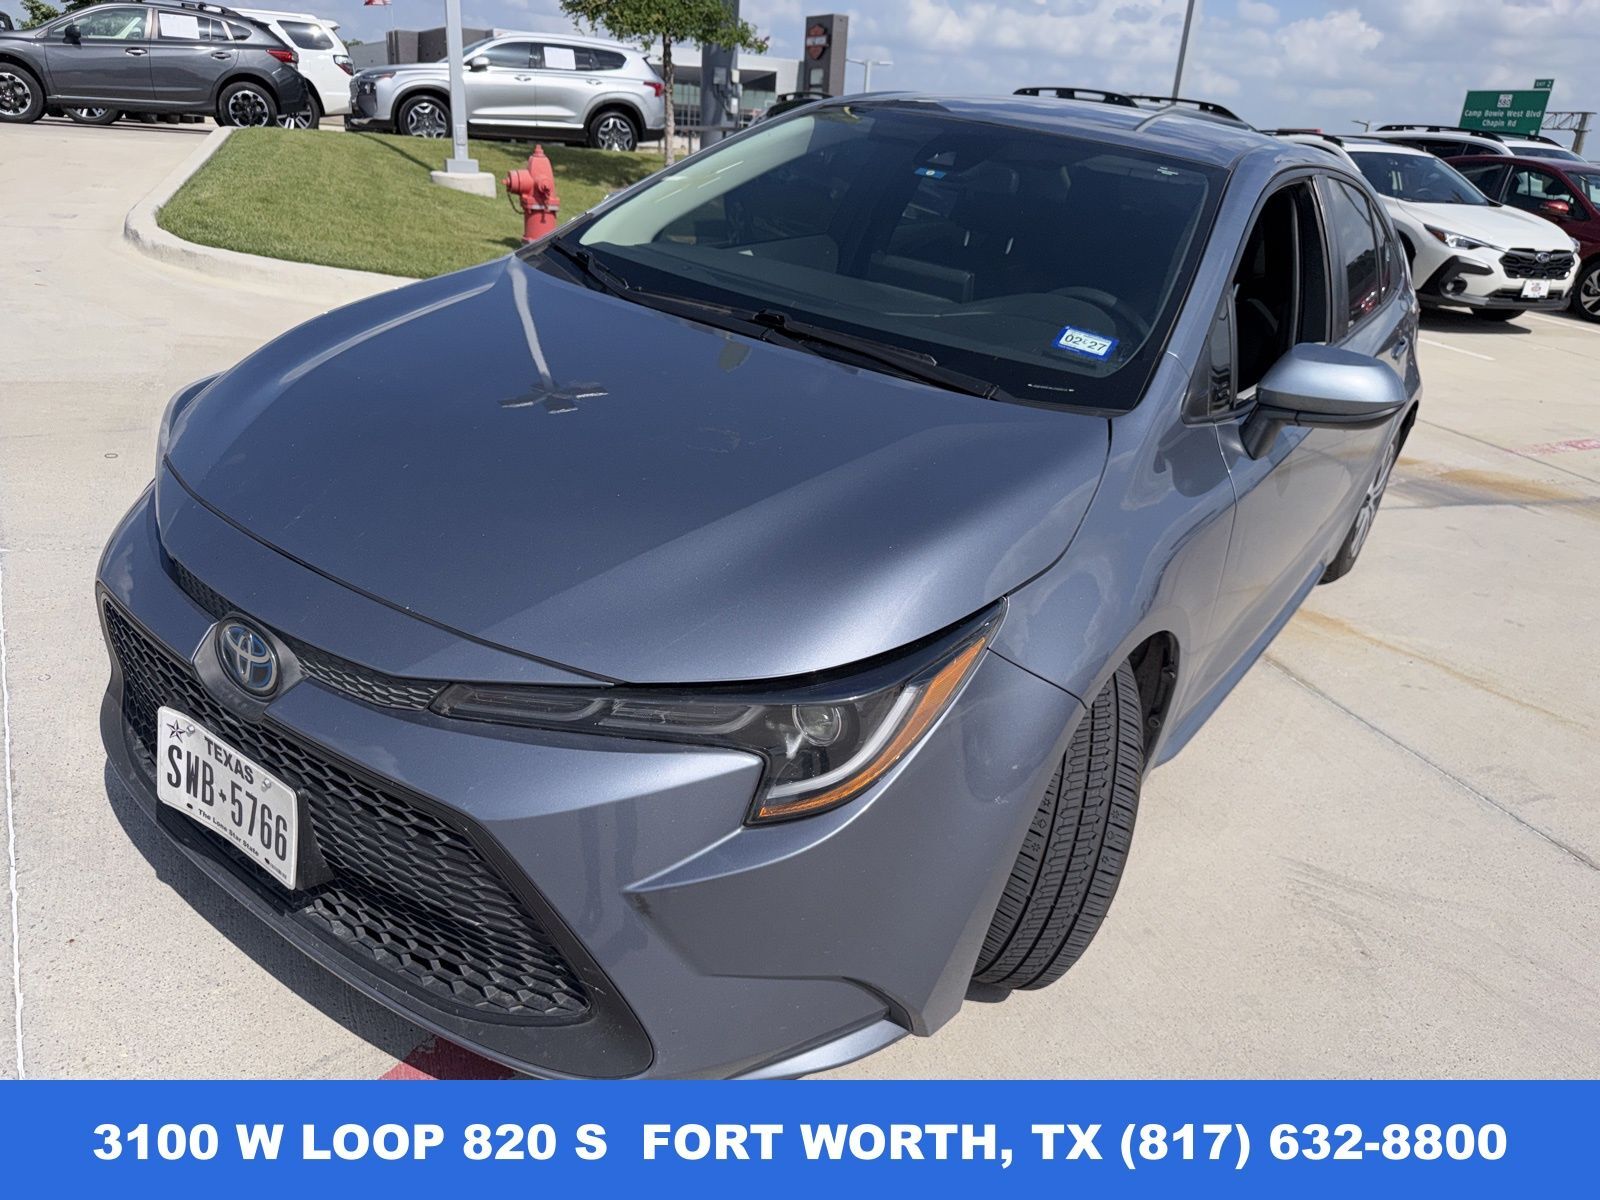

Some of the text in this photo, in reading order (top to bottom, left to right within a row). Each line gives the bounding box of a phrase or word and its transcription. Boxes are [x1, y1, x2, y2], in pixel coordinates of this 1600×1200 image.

[1464, 109, 1542, 118] Camp Bowie West Blvd
[1482, 119, 1505, 128] Chapin
[1065, 334, 1083, 345] 02
[1087, 341, 1107, 351] 27
[204, 736, 254, 785] TEXAS
[167, 745, 288, 862] SWB 5766
[198, 808, 260, 857] The Lone Star State
